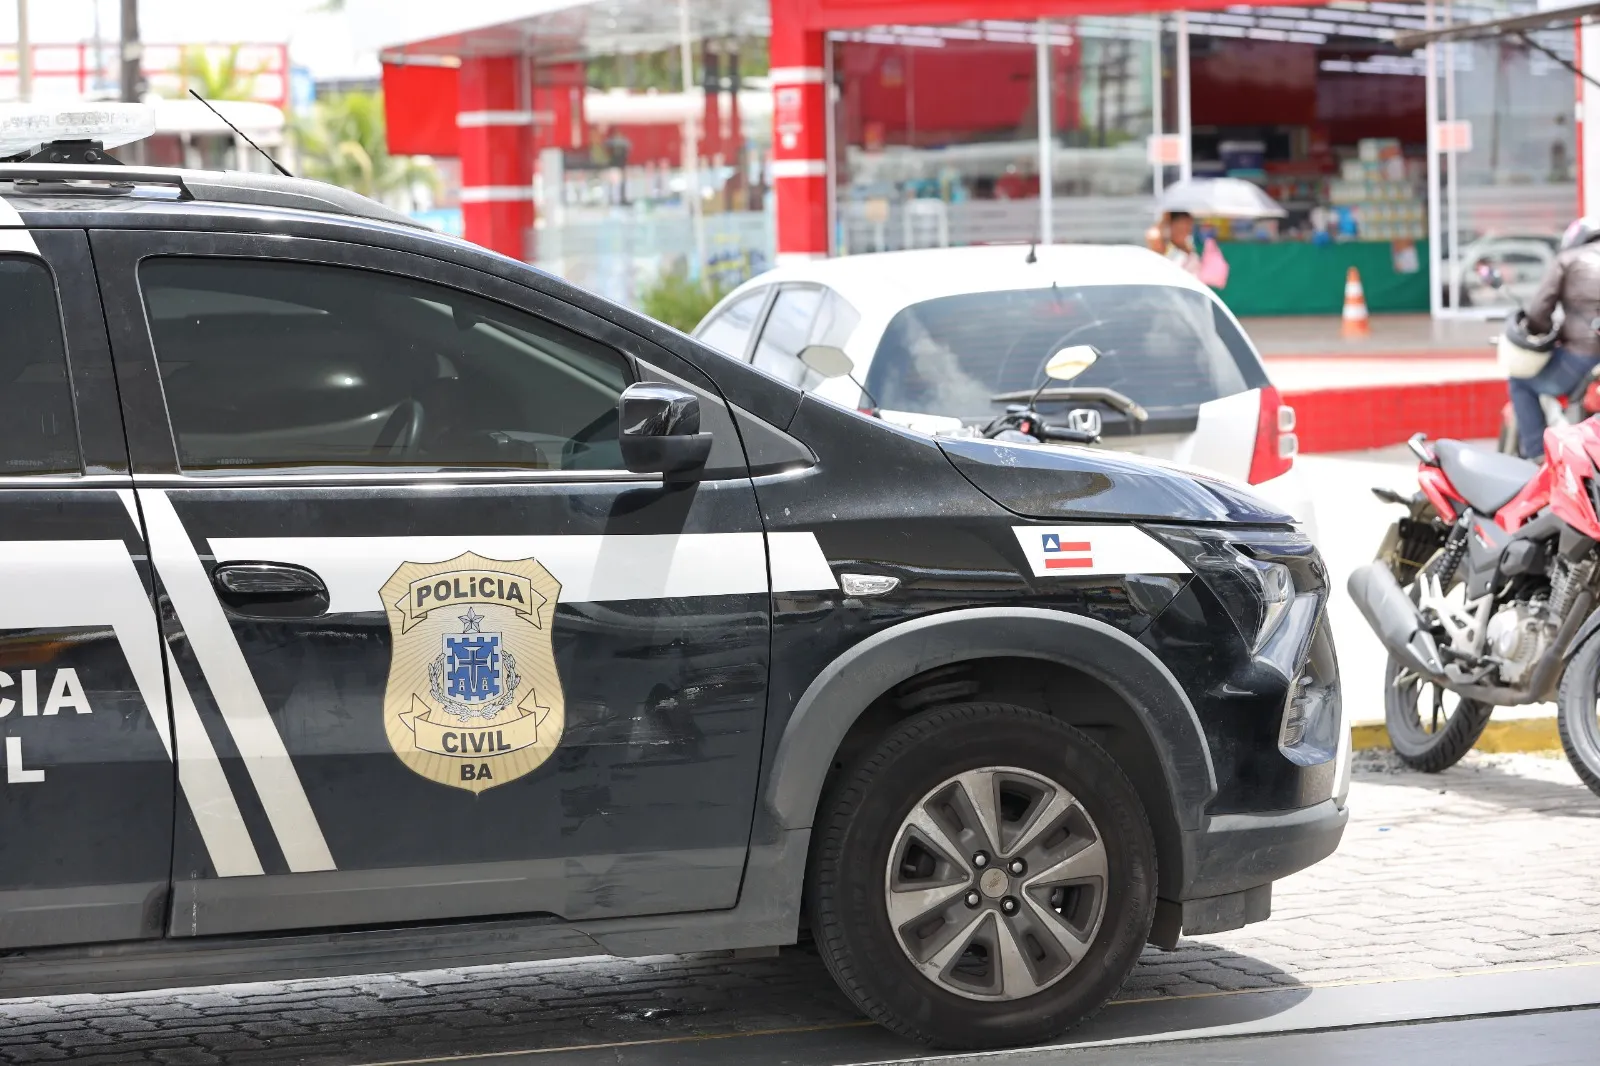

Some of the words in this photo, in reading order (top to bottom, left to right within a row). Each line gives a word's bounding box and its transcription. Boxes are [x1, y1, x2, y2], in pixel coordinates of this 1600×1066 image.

[441, 730, 512, 753] CIVIL
[5, 736, 46, 784] L
[460, 763, 493, 781] BA
